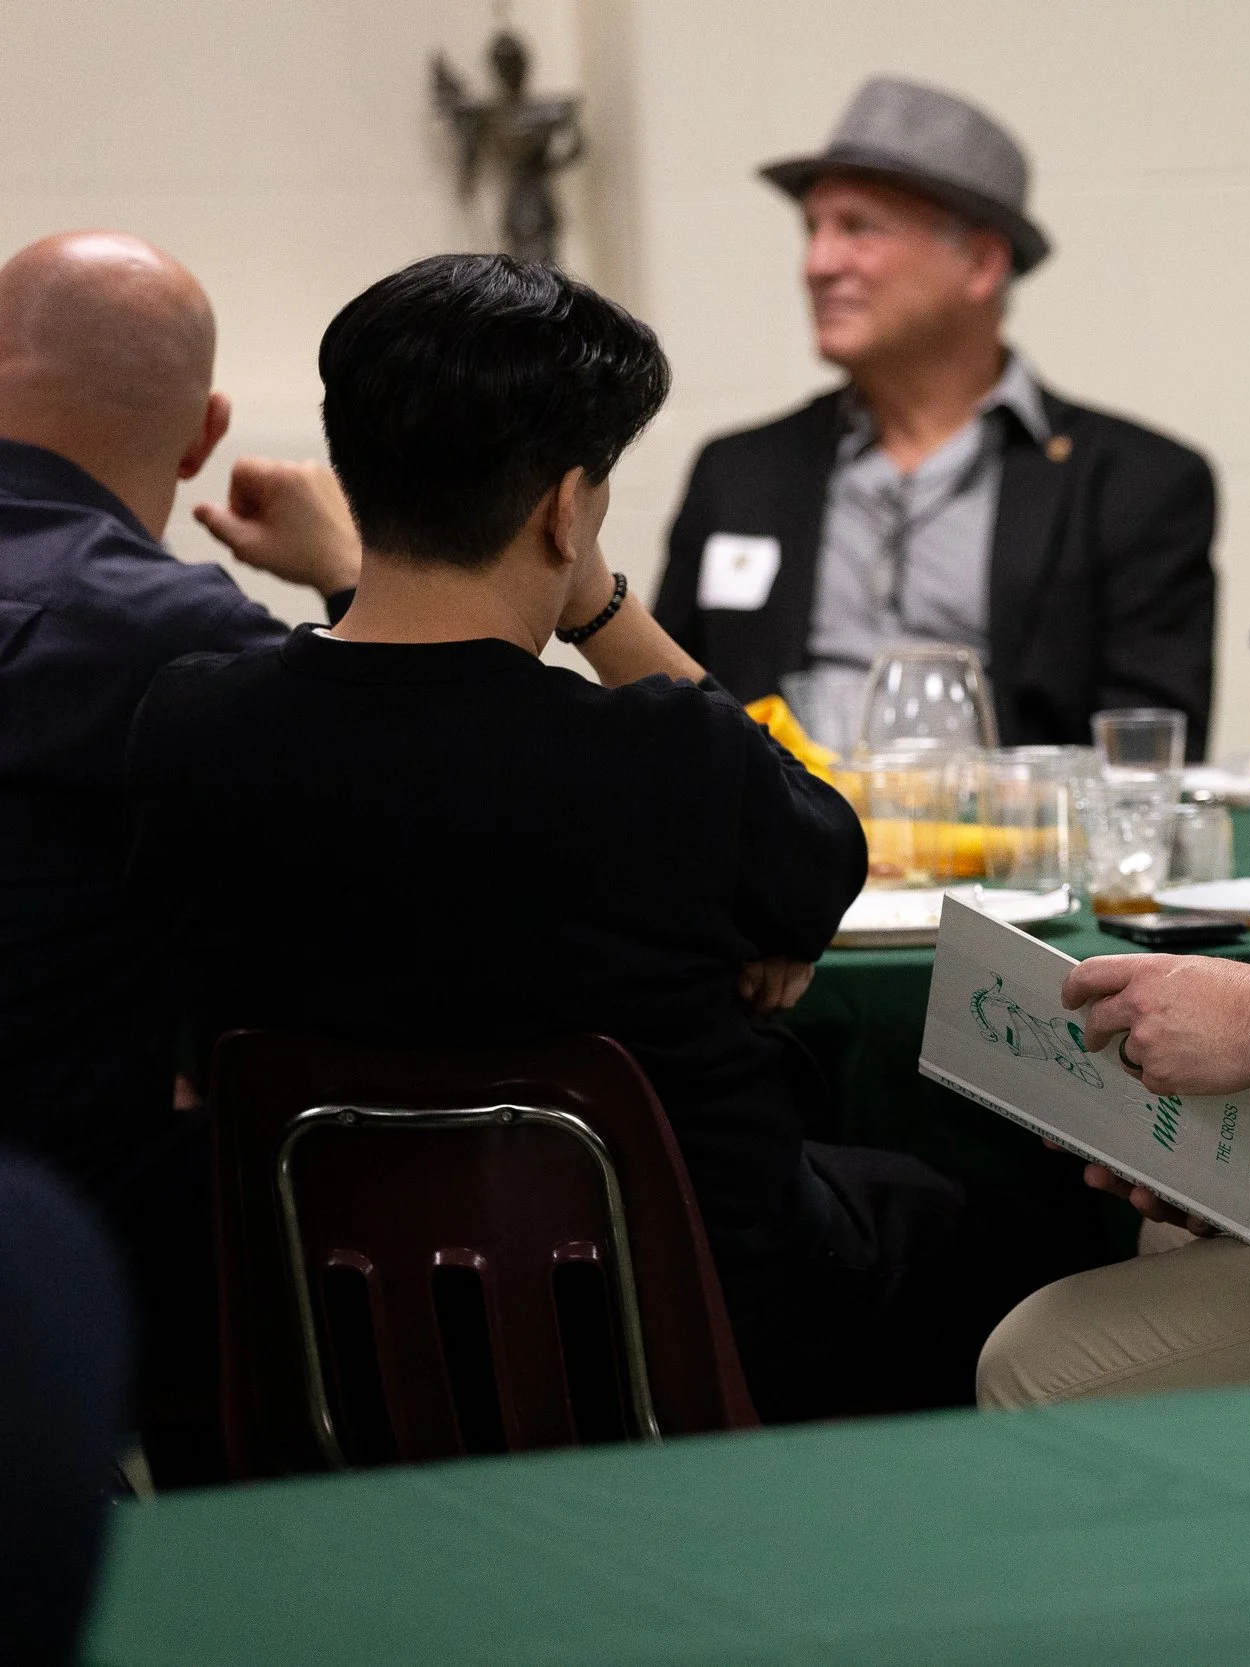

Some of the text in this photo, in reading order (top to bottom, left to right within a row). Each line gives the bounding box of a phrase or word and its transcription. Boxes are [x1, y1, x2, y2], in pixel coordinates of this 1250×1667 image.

[941, 1076, 975, 1098] HOLY
[980, 1096, 1028, 1126] CROSS
[1031, 1124, 1065, 1146] HIGH
[1068, 1144, 1126, 1177] SCHOOL
[1216, 1103, 1238, 1164] THE CROSS
